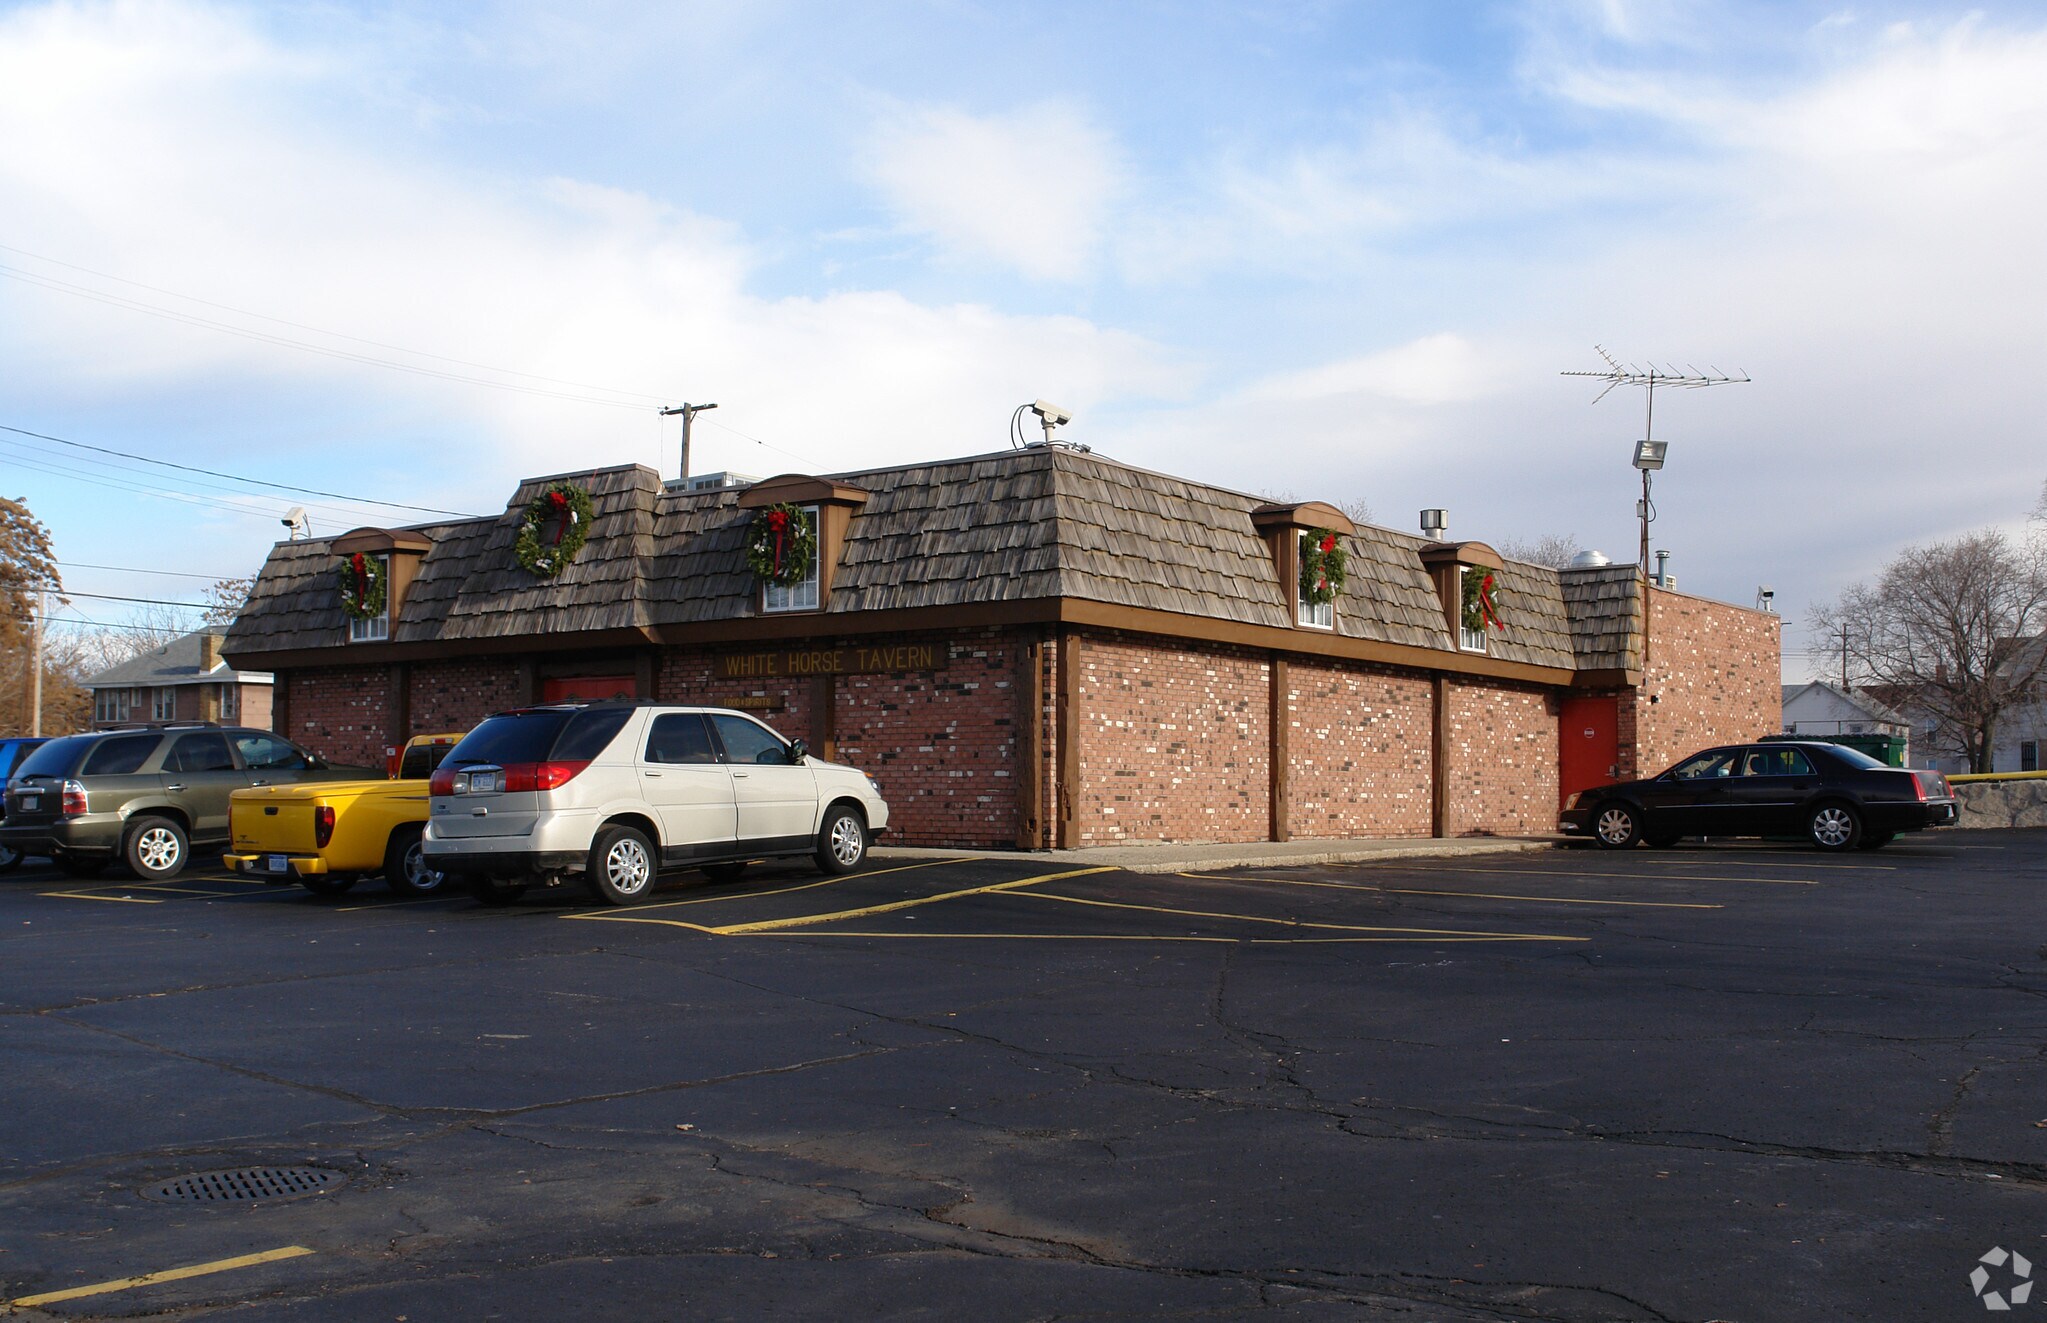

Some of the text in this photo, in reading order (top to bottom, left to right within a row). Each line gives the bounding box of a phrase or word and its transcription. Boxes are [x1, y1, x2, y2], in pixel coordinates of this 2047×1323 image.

[726, 646, 932, 675] WHITE HORSE TAVERN
